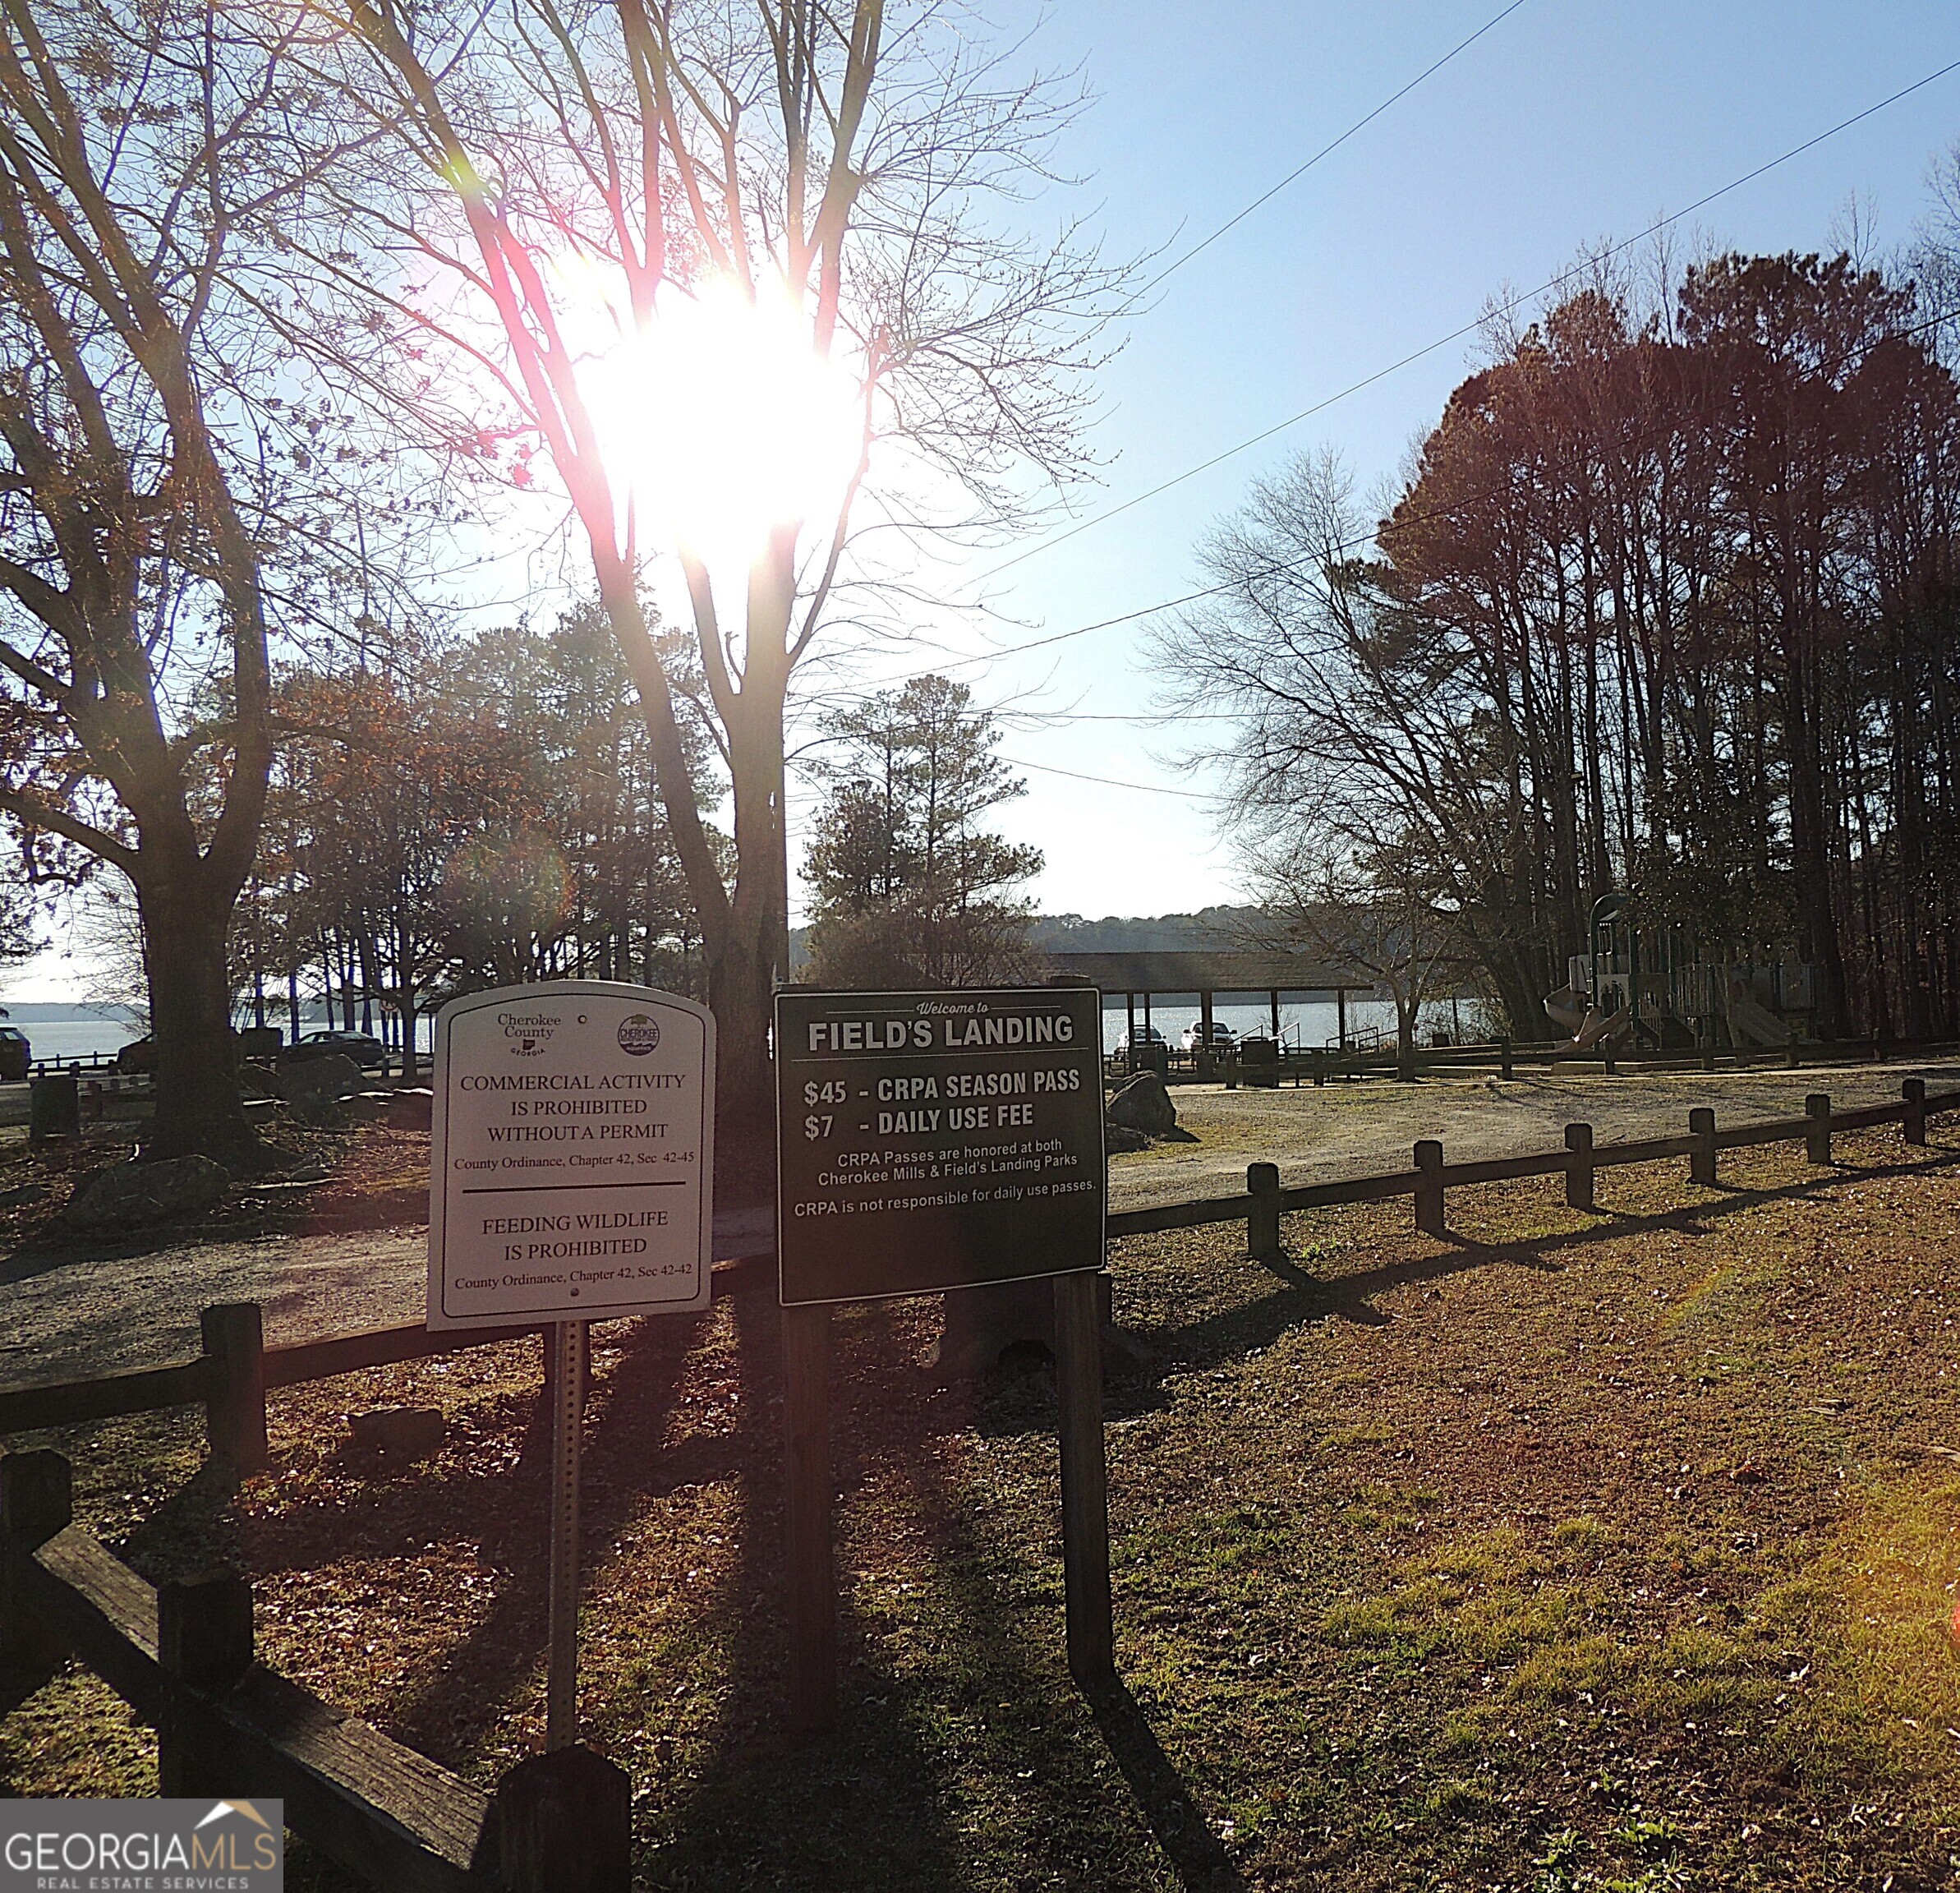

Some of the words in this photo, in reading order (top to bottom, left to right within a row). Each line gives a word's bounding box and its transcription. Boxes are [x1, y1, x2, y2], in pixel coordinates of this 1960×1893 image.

[498, 1013, 561, 1025] Cherokee
[917, 1002, 974, 1015] Welcome
[977, 1002, 989, 1013] to
[504, 1025, 554, 1040] County
[808, 1020, 932, 1051] FIELD'S
[945, 1016, 1073, 1047] LANDING
[510, 1048, 545, 1057] GEORGIA
[461, 1075, 594, 1091] COMMERCIAL
[598, 1074, 686, 1089] ACTIVITY
[804, 1080, 846, 1106] $45
[878, 1077, 938, 1102] CRPA
[946, 1072, 1026, 1097] SEASON
[1034, 1069, 1079, 1092] PASS
[512, 1102, 528, 1116] IS
[534, 1099, 646, 1115] PROHIBITED
[805, 1115, 833, 1140] $7
[879, 1109, 941, 1134] DAILY
[950, 1107, 988, 1130] USE
[998, 1103, 1033, 1126] FEE
[487, 1126, 578, 1142] WITHOUT
[581, 1126, 594, 1140] A
[600, 1124, 668, 1139] PERMIT
[455, 1158, 498, 1171] County
[502, 1157, 565, 1168] Ordinance,
[569, 1155, 614, 1167] Chapter
[616, 1154, 633, 1165] 42,
[637, 1154, 656, 1163] Sec
[664, 1152, 694, 1163] 42-45
[838, 1153, 881, 1168] CRPA
[885, 1150, 934, 1164] Passes
[939, 1148, 959, 1160] are
[964, 1142, 1017, 1158] honored
[1021, 1141, 1032, 1153] at
[1036, 1139, 1061, 1152] both
[818, 1169, 888, 1186] Cherokee
[894, 1167, 925, 1181] Mills
[930, 1165, 940, 1177] &
[945, 1162, 987, 1176] Field's
[992, 1157, 1041, 1172] Landing
[1045, 1154, 1077, 1168] Parks
[794, 1201, 838, 1217] CRPA
[842, 1200, 854, 1213] is
[859, 1199, 883, 1212] not
[888, 1191, 968, 1211] responsible
[973, 1189, 990, 1202] for
[994, 1186, 1023, 1200] daily
[1027, 1184, 1048, 1195] use
[1052, 1180, 1096, 1196] passes.
[482, 1215, 571, 1234] FEEDING
[576, 1211, 668, 1229] WILDLIFE
[504, 1245, 522, 1260] IS
[528, 1238, 647, 1259] PROHIBITED
[455, 1278, 499, 1290] County
[503, 1274, 566, 1286] Ordinance,
[570, 1270, 614, 1282] Chapter
[618, 1268, 634, 1278] 42,
[638, 1267, 657, 1278] Sec
[660, 1264, 692, 1275] 42-42
